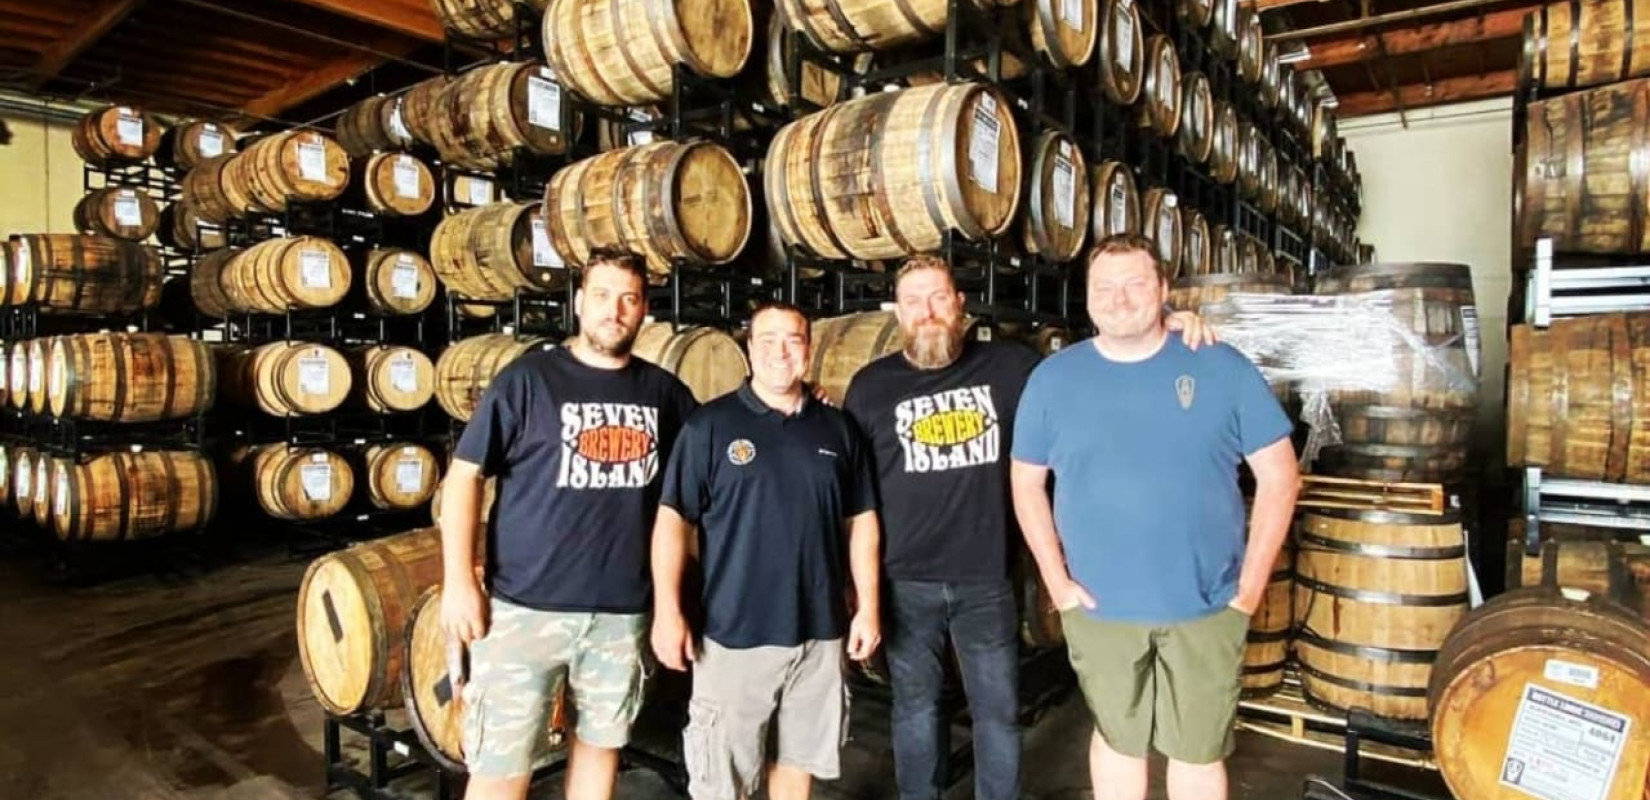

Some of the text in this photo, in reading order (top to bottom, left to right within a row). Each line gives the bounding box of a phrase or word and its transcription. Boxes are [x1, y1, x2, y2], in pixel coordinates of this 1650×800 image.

[561, 402, 659, 443] SEVEN
[895, 385, 998, 435] SEVEN
[913, 410, 984, 445] BREWERY
[556, 442, 659, 488] ISLAND
[578, 427, 650, 462] BREWERY
[899, 422, 1000, 473] ISLAND
